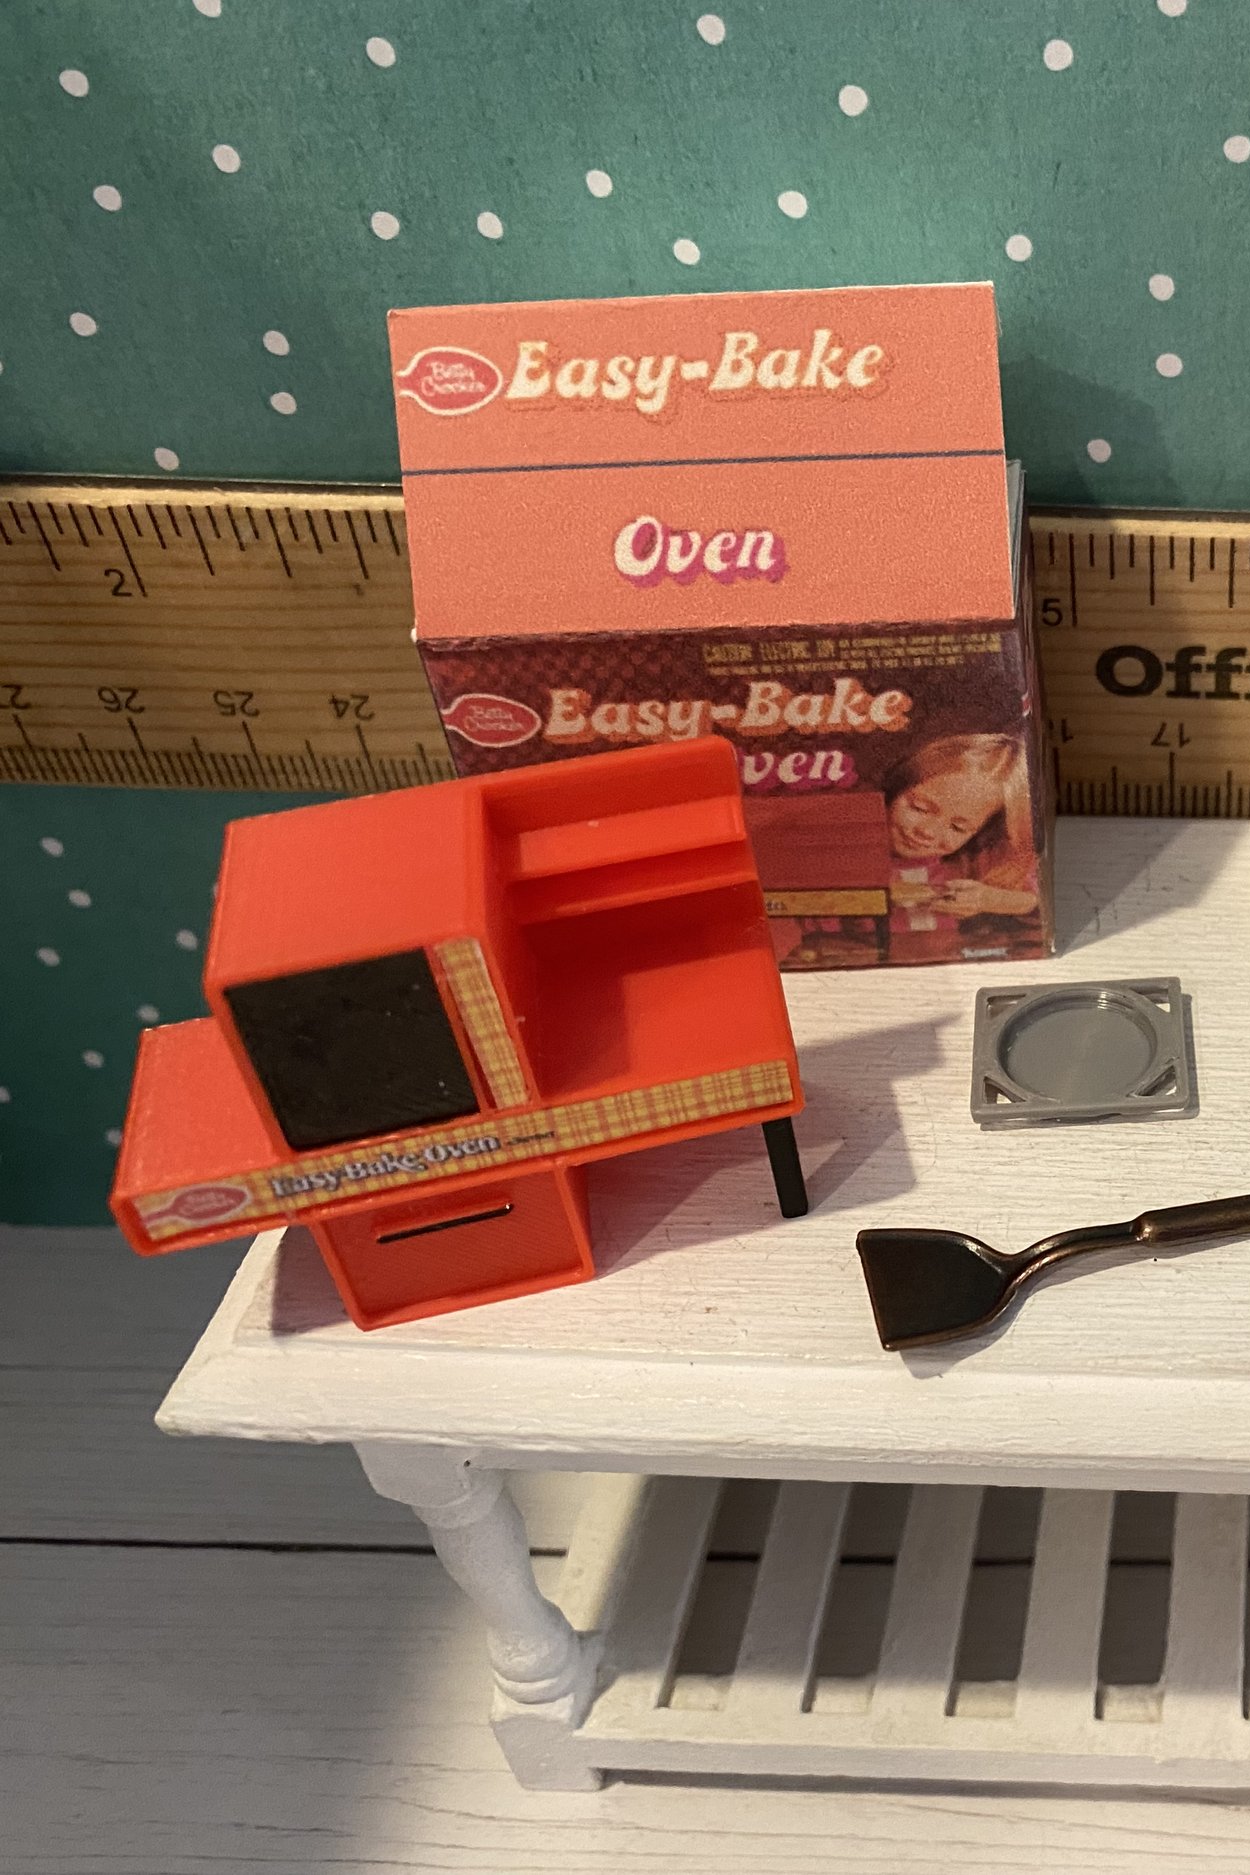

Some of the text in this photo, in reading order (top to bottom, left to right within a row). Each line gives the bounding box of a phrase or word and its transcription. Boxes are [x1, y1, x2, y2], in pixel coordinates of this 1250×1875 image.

[504, 329, 884, 412] Easy-Bake
[614, 515, 776, 576] Oven
[104, 569, 132, 597] 2
[1041, 599, 1064, 627] 5
[543, 679, 908, 741] Easy-Bake
[1150, 722, 1191, 748] 17
[742, 747, 846, 785] ven
[423, 1134, 501, 1164] Oven
